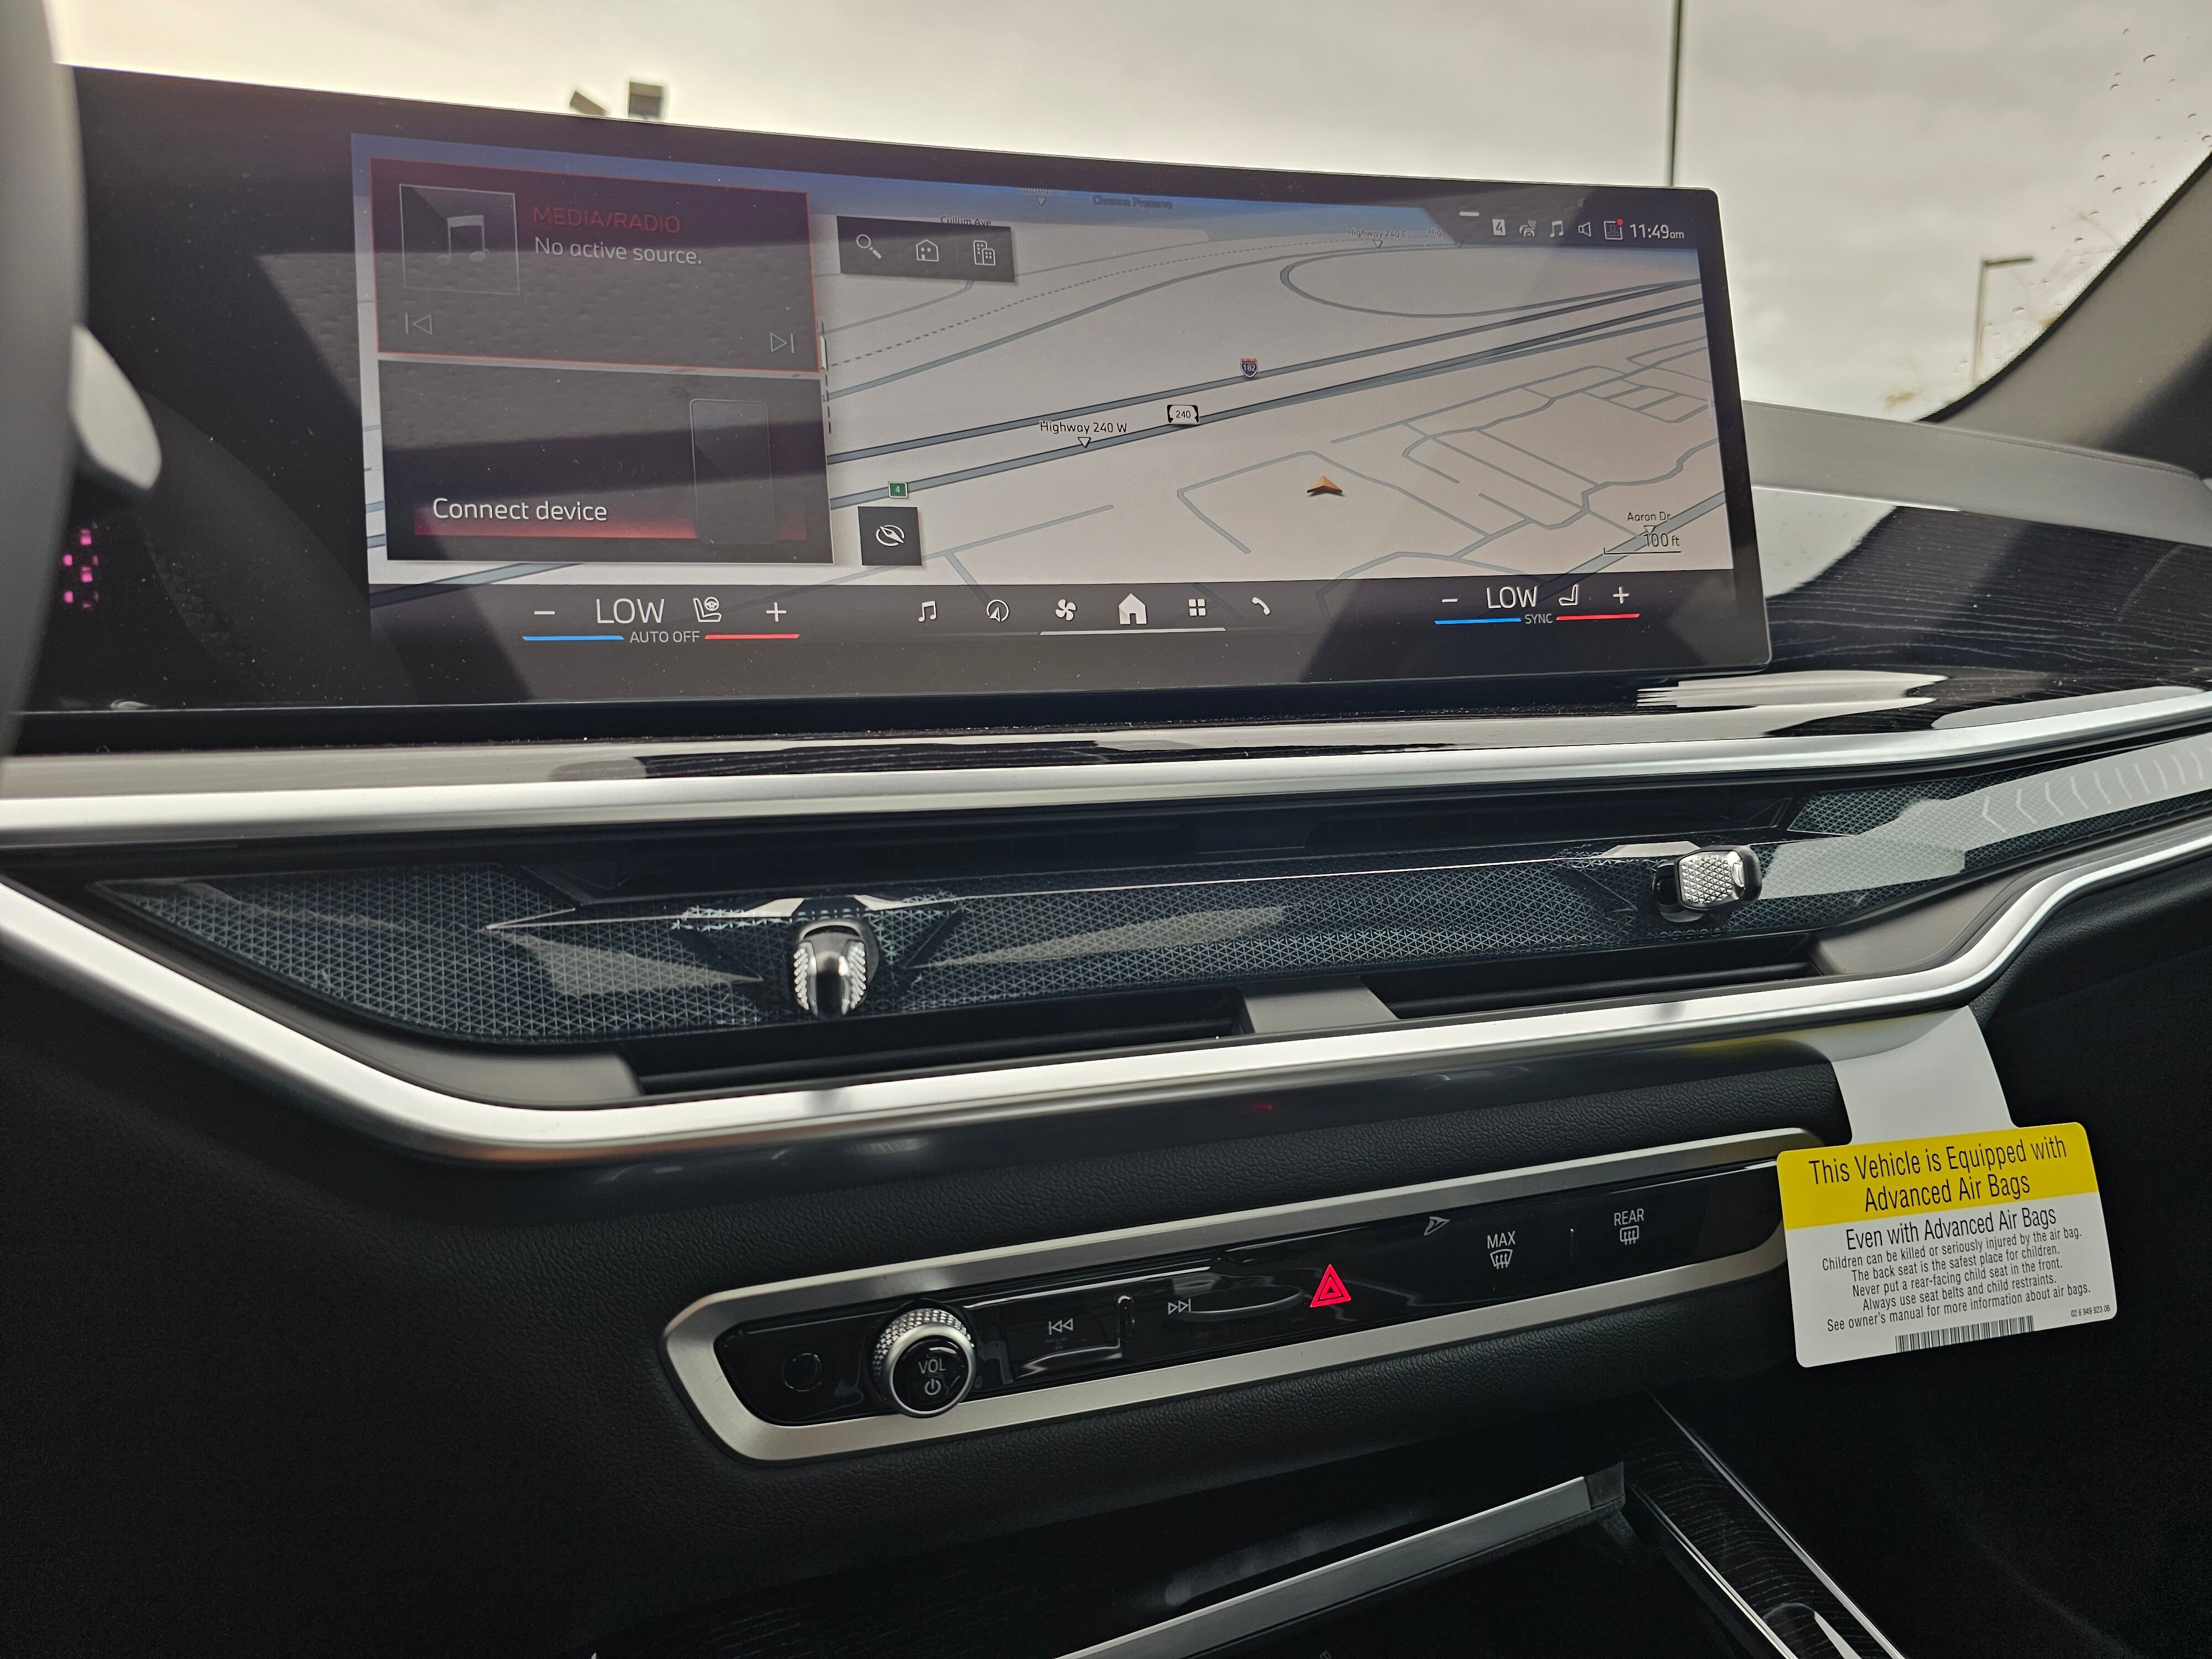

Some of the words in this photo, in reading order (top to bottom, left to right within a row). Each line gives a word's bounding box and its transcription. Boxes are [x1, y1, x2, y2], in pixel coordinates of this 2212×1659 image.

[533, 207, 681, 233] MEDIA/RADIO
[941, 216, 972, 225] Cullum
[974, 218, 992, 226] Ave
[1347, 229, 1383, 238] Highway
[1385, 230, 1400, 238] 240
[1630, 223, 1684, 239] 11:49am
[535, 237, 564, 255] No
[570, 242, 627, 260] active
[633, 248, 702, 264] source.
[1242, 364, 1256, 372] 182
[1175, 410, 1191, 419] 240
[1040, 422, 1090, 435] Highway
[1093, 422, 1114, 433] 240
[1117, 422, 1128, 433] W
[434, 498, 529, 520] Connect
[536, 501, 607, 521] device
[1627, 512, 1656, 521] Aaron
[1659, 512, 1671, 521] Dr
[1643, 533, 1669, 547] 100
[1672, 535, 1680, 546] ft
[1486, 586, 1537, 609] LOW
[596, 598, 665, 624] LOW
[1525, 614, 1553, 624] SYNC
[630, 631, 669, 643] AUTO
[673, 631, 700, 643] OFF
[1809, 1159, 1850, 1184] This
[1854, 1151, 1920, 1179] Vehicle
[1926, 1149, 1941, 1172] is
[1946, 1139, 2026, 1173] Equipped
[2031, 1135, 2067, 1160] with
[1865, 1179, 1952, 1212] Advanced
[1959, 1176, 1981, 1201] Air
[1987, 1173, 2030, 1199] Bags
[1614, 1208, 1645, 1226] REAR
[1846, 1229, 1882, 1250] Even
[1887, 1222, 1919, 1244] with
[1924, 1212, 1994, 1240] Advanced
[2000, 1209, 2017, 1231] Air
[2022, 1207, 2056, 1229] Bags
[1487, 1230, 1516, 1249] MAX
[1823, 1256, 1863, 1270] Children
[1867, 1254, 1883, 1265] can
[1886, 1250, 1897, 1262] be
[1901, 1246, 1925, 1260] killed
[1929, 1246, 1938, 1256] or
[1942, 1239, 1983, 1255] seriously
[1986, 1234, 2017, 1250] injured
[2020, 1233, 2030, 1246] by
[2033, 1231, 2047, 1243] the
[2050, 1228, 2060, 1240] air
[2063, 1227, 2082, 1239] bag.
[1851, 1270, 1869, 1281] The
[1872, 1265, 1895, 1279] back
[1898, 1262, 1917, 1275] seat
[1921, 1261, 1928, 1272] is
[1932, 1259, 1946, 1271] the
[1950, 1254, 1976, 1269] safest
[1980, 1252, 2003, 1267] place
[2006, 1249, 2018, 1261] for
[2022, 1245, 2060, 1259] children.
[1853, 1284, 1880, 1297] Never
[1884, 1280, 1900, 1296] put
[1902, 1281, 1907, 1290] a
[1911, 1273, 1961, 1290] rear-facing
[1965, 1267, 1986, 1282] child
[1990, 1264, 2008, 1278] seat
[2011, 1263, 2019, 1275] in
[2022, 1261, 2036, 1274] the
[2038, 1259, 2063, 1271] front.
[1863, 1297, 1896, 1311] Always
[1900, 1295, 1916, 1306] use
[1919, 1290, 1939, 1302] seat
[1942, 1286, 1964, 1300] belts
[1968, 1283, 1984, 1296] and
[1987, 1279, 2008, 1293] child
[2012, 1274, 2057, 1288] restraints.
[1827, 1319, 1845, 1332] See
[1849, 1312, 1886, 1328] owner's
[1890, 1306, 1924, 1322] manual
[1927, 1305, 1940, 1317] for
[1944, 1302, 1967, 1314] more
[1970, 1293, 2022, 1310] information
[2026, 1288, 2051, 1302] about
[2053, 1286, 2064, 1298] air
[2067, 1284, 2091, 1297] bags.
[2093, 1306, 2103, 1314] 923
[918, 1358, 947, 1374] VOL
